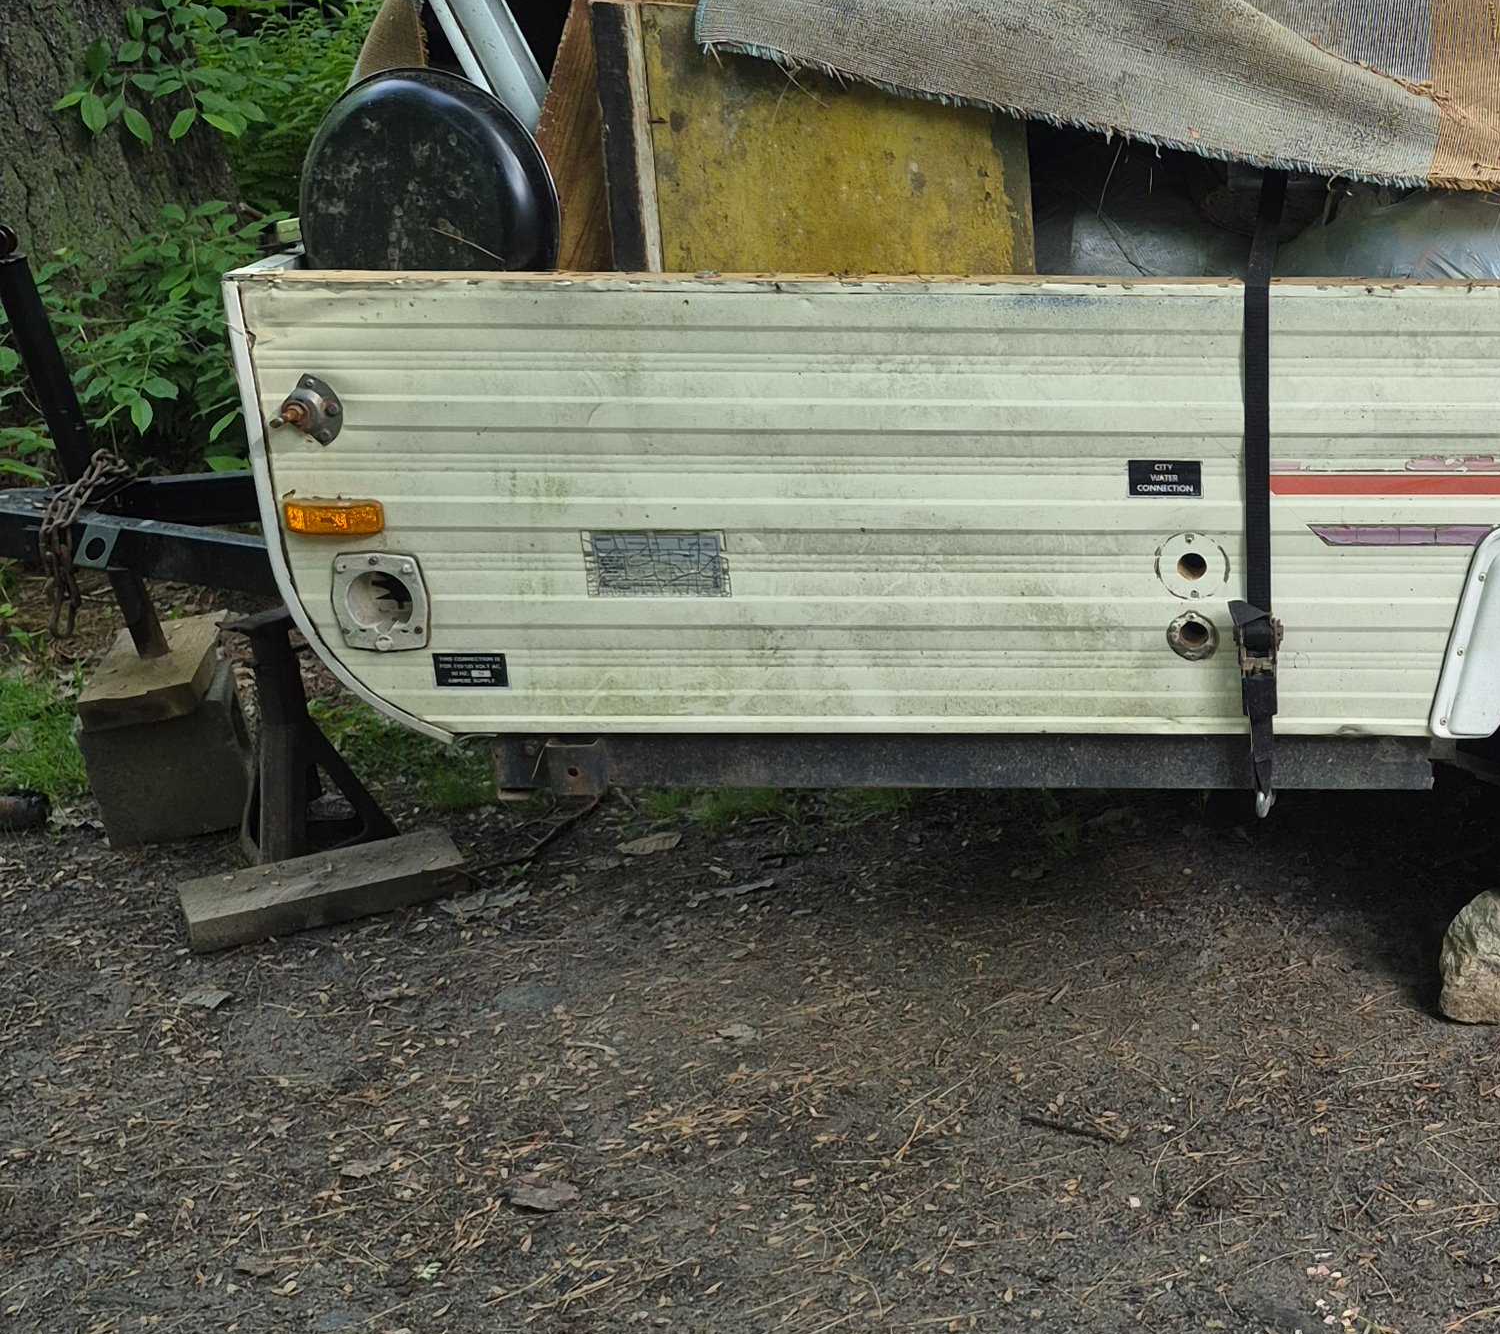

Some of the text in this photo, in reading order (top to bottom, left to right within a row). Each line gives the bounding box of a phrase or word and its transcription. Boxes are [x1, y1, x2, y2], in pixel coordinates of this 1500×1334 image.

[1154, 463, 1173, 471] CITY
[1149, 474, 1179, 482] WATER
[1136, 484, 1194, 492] CONNECTION
